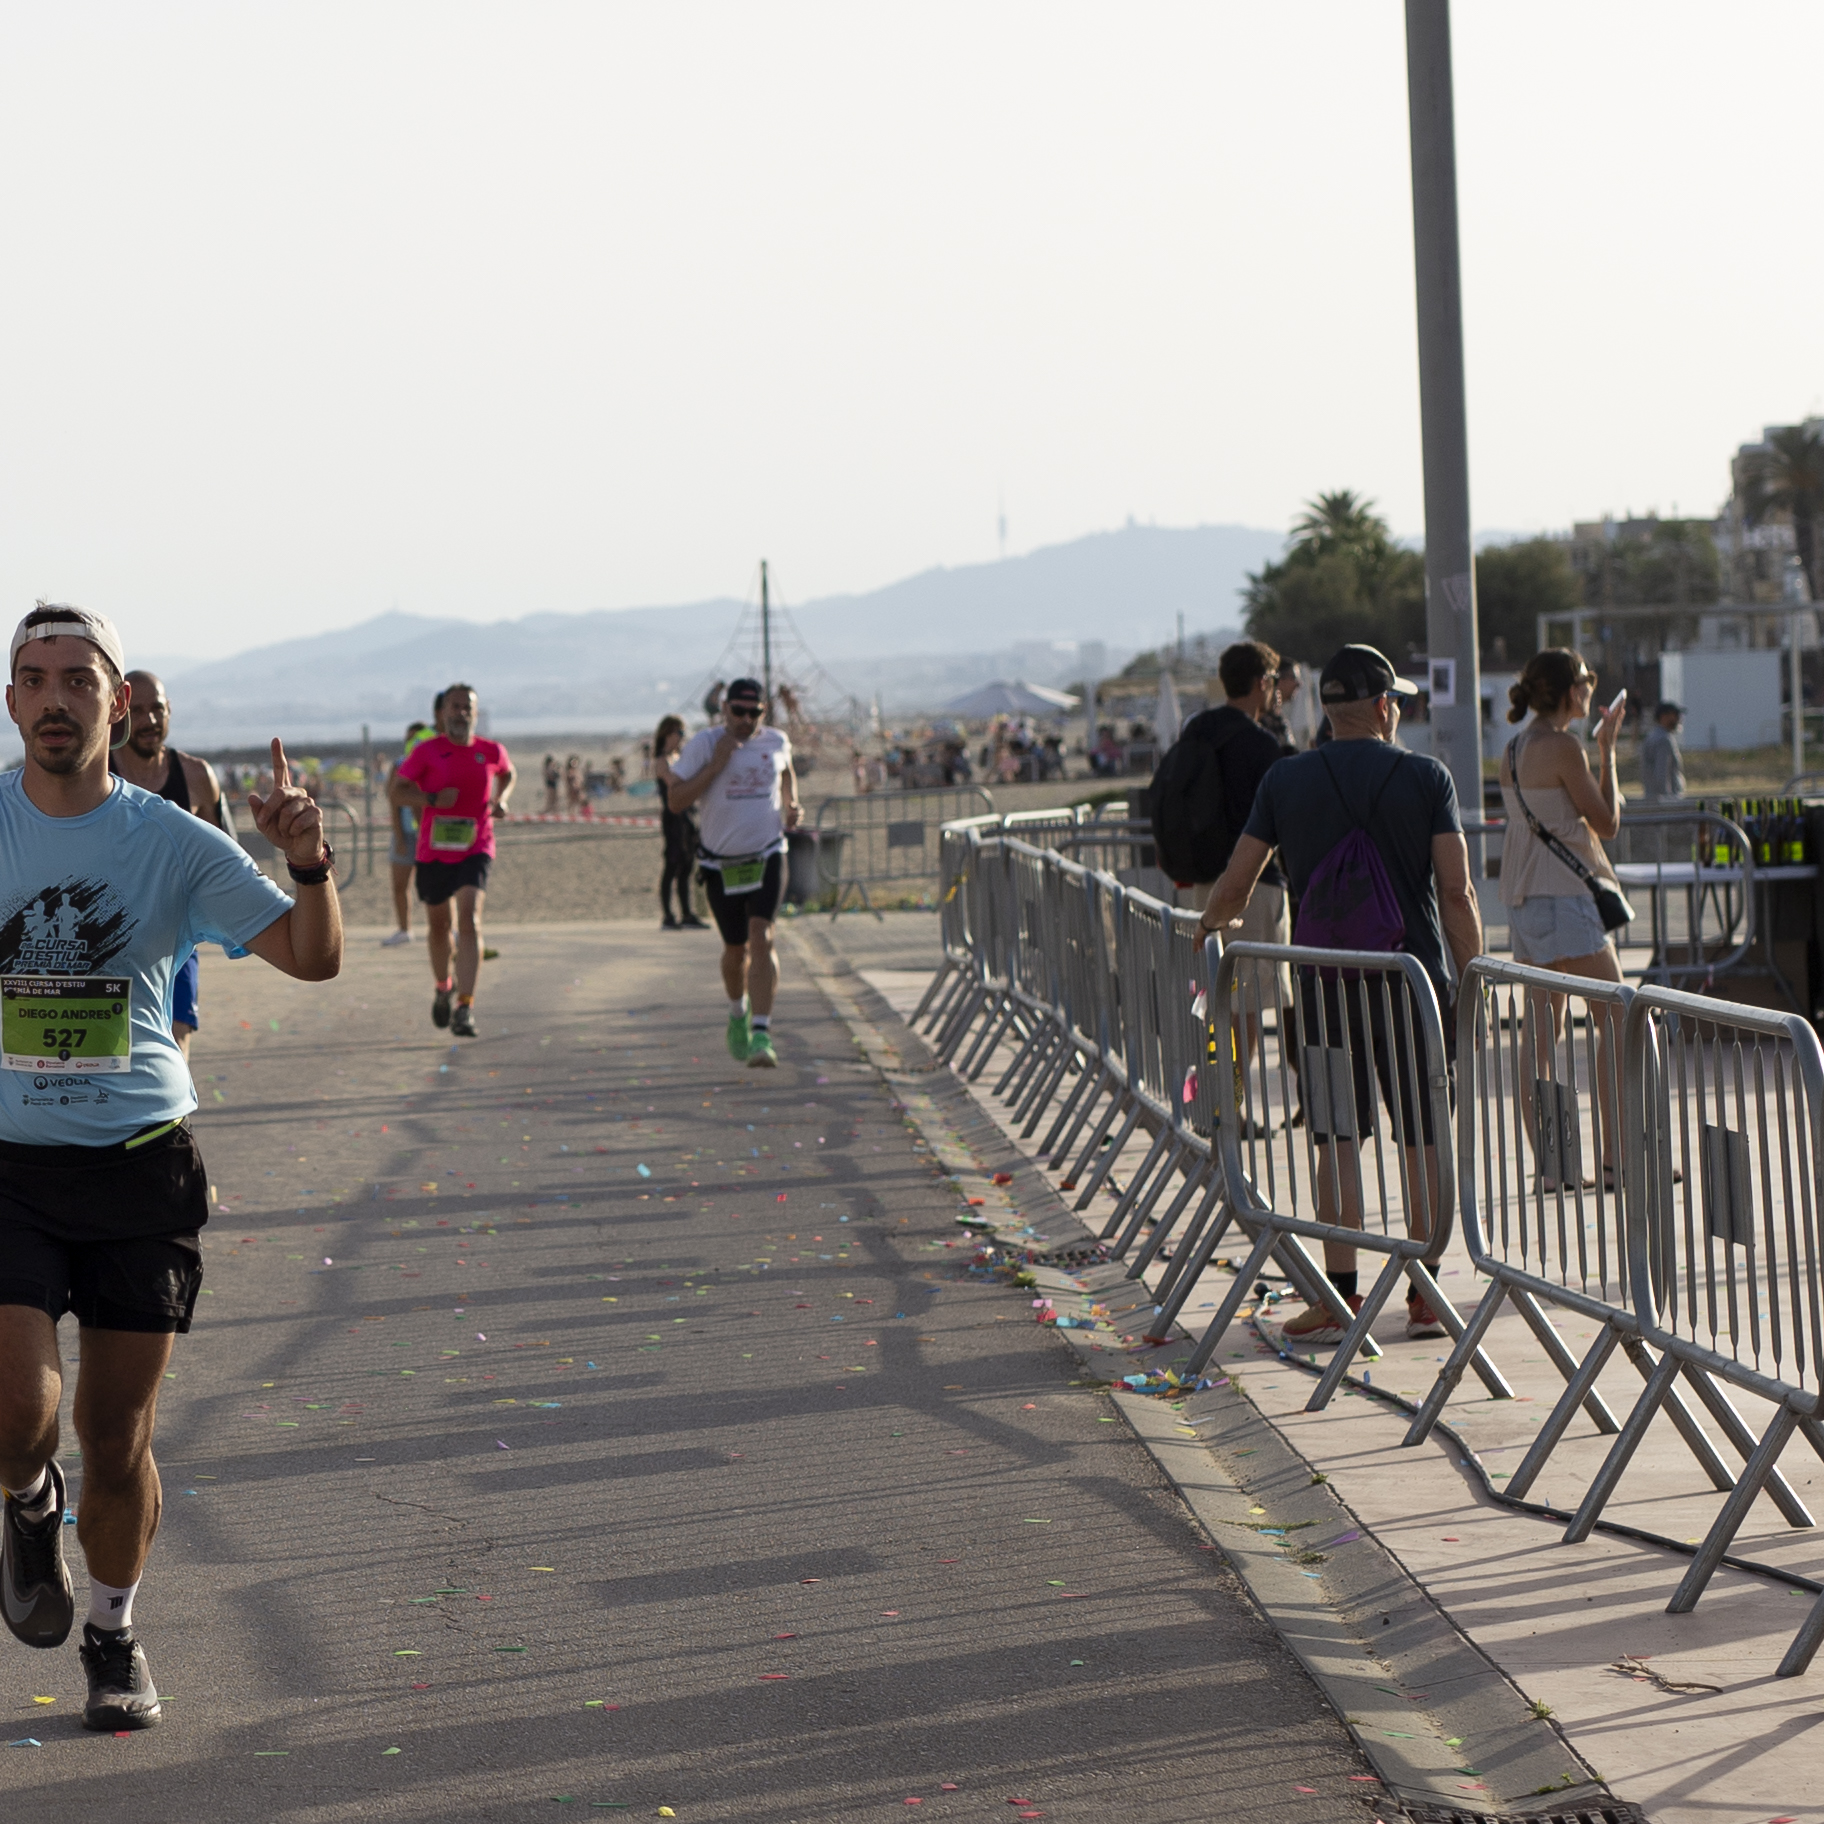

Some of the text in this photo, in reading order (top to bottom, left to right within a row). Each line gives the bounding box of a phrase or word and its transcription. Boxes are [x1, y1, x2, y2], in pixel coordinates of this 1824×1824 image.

[35, 939, 87, 952] CURSA
[22, 950, 78, 961] D'ESTIU
[105, 983, 121, 993] 5K
[18, 1008, 112, 1020] DIEGO ANDRES
[42, 1028, 87, 1048] 527
[49, 1077, 91, 1087] VEOLIA
